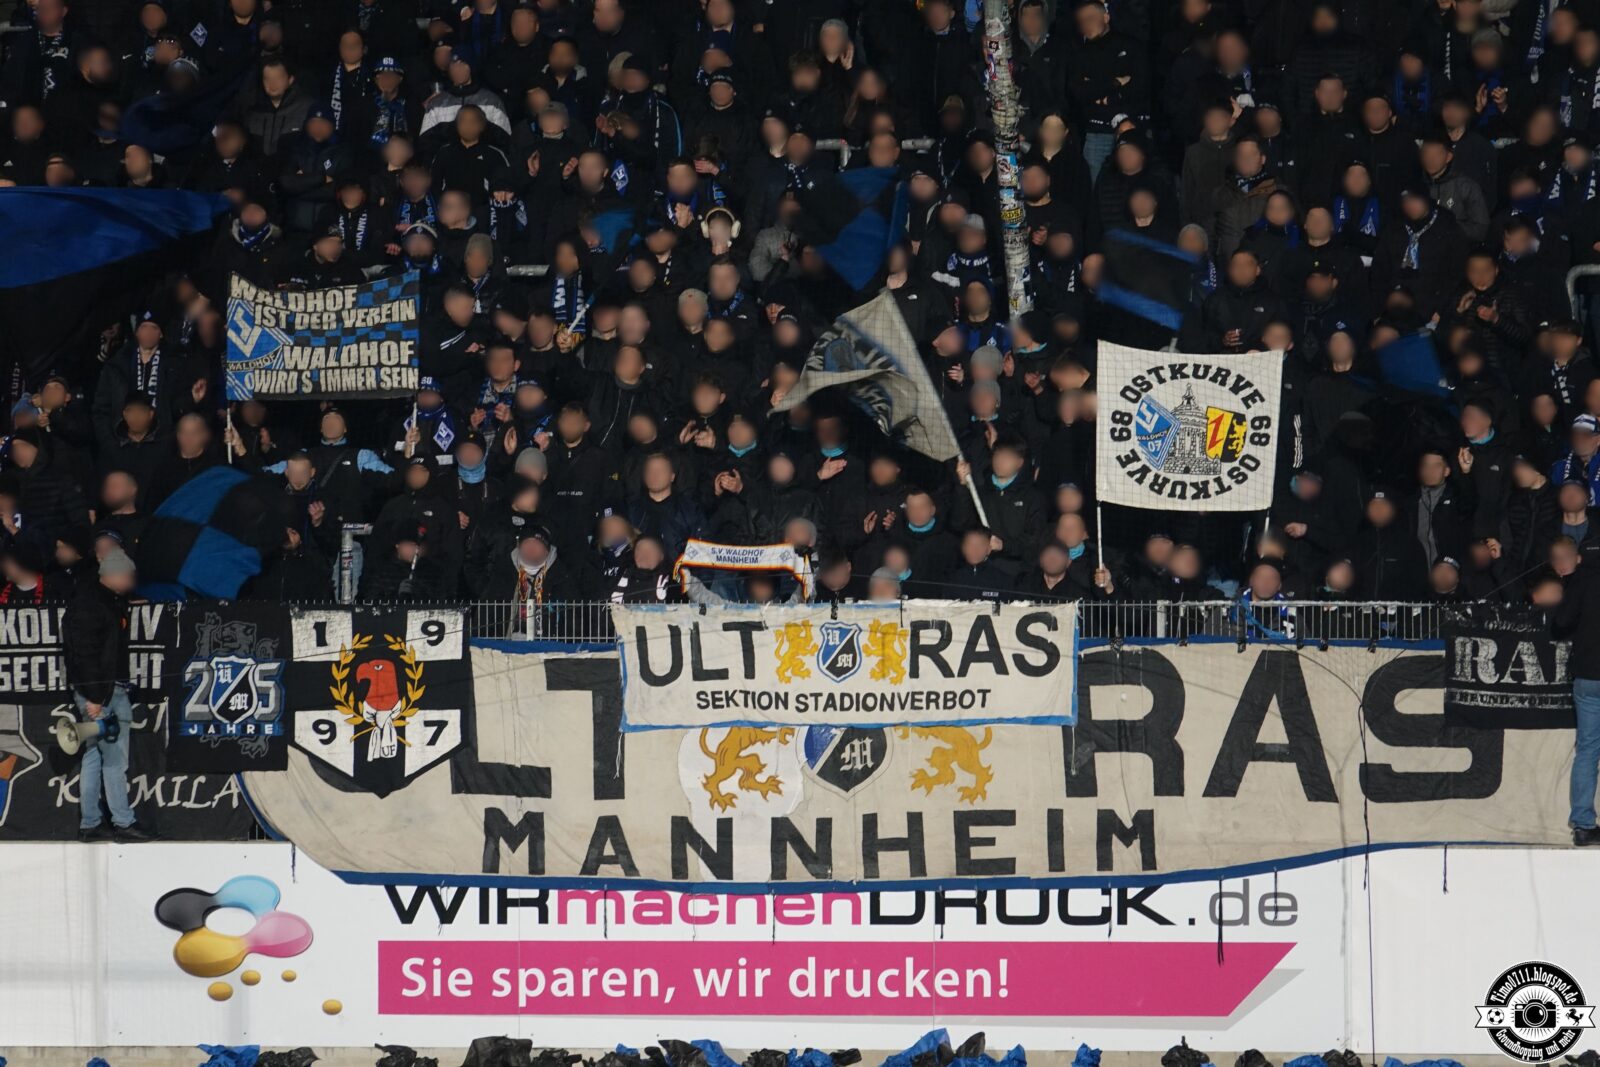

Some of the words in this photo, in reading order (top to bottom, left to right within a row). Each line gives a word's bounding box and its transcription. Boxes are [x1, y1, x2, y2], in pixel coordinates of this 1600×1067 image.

[230, 271, 358, 313] WALDHOF
[254, 303, 290, 329] IST
[294, 311, 337, 331] DER
[341, 299, 416, 329] VEREIN
[283, 341, 414, 370] WALDHOF
[320, 367, 377, 392] IMMER
[380, 367, 419, 390] SEIN
[1119, 363, 1266, 410] OSTKURVE
[1110, 410, 1133, 442] 68
[1250, 415, 1272, 447] 68
[1147, 439, 1162, 452] 07
[1115, 448, 1261, 500] OSTKURVE
[716, 556, 759, 564] MANNHEIM
[725, 549, 764, 557] WALDHOF
[312, 621, 328, 647] 1
[421, 620, 446, 646] 9
[185, 661, 280, 720] 25
[696, 690, 790, 711] SEKTION
[795, 689, 992, 713] STADIONVERBOT
[188, 723, 273, 735] JAHRE
[312, 719, 337, 745] 9
[423, 720, 448, 746] 7
[381, 744, 396, 757] UF
[482, 807, 1158, 882] MANNHEIM
[401, 957, 474, 998] Sie
[492, 965, 676, 1007] sparen,
[693, 957, 771, 998] wir
[788, 956, 1009, 998] drucken!
